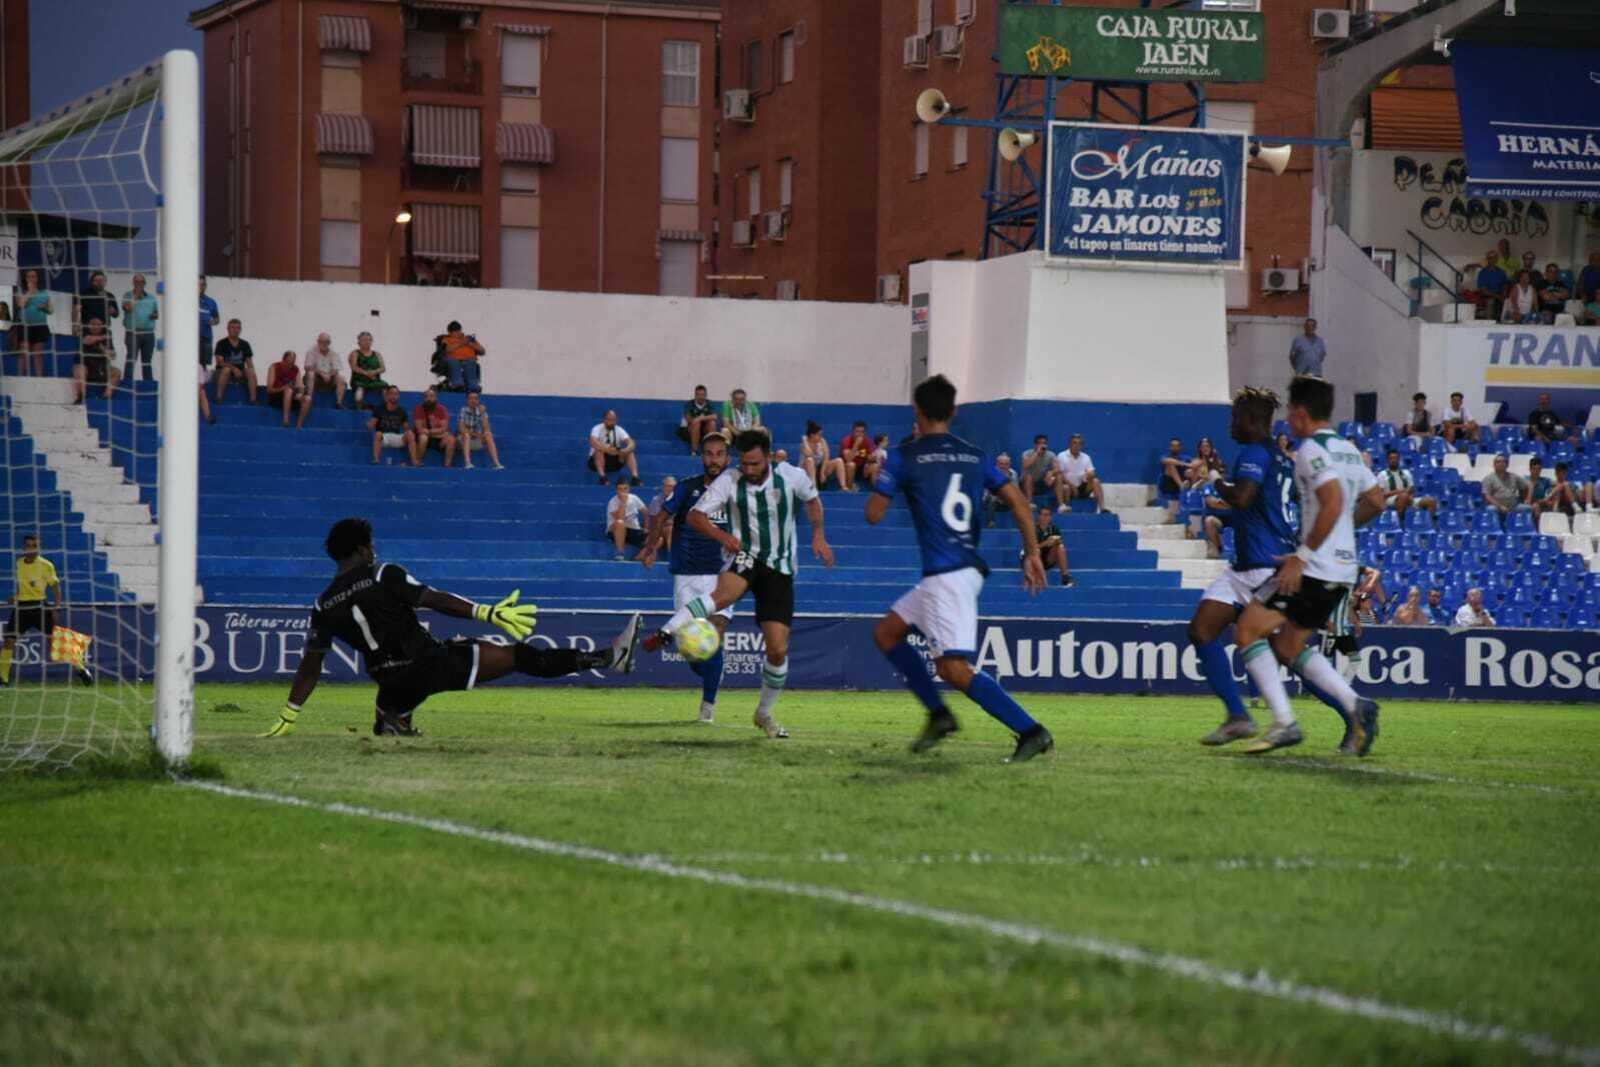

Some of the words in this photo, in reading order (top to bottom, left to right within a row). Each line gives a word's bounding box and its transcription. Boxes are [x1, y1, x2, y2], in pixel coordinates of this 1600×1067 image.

[1096, 15, 1162, 39] CAJA
[1166, 16, 1258, 42] RURAL
[1142, 40, 1210, 66] JAÉN
[1070, 144, 1222, 181] Mañas
[1069, 187, 1135, 209] BAR
[1139, 193, 1181, 209] LOS
[1486, 187, 1540, 198] MATERIALES
[1541, 188, 1553, 198] DE
[1072, 213, 1223, 238] JAMONES
[1110, 239, 1122, 251] en
[1123, 239, 1158, 252] linares
[1159, 240, 1184, 253] tiene
[941, 473, 972, 532] 6
[351, 604, 379, 651] 1
